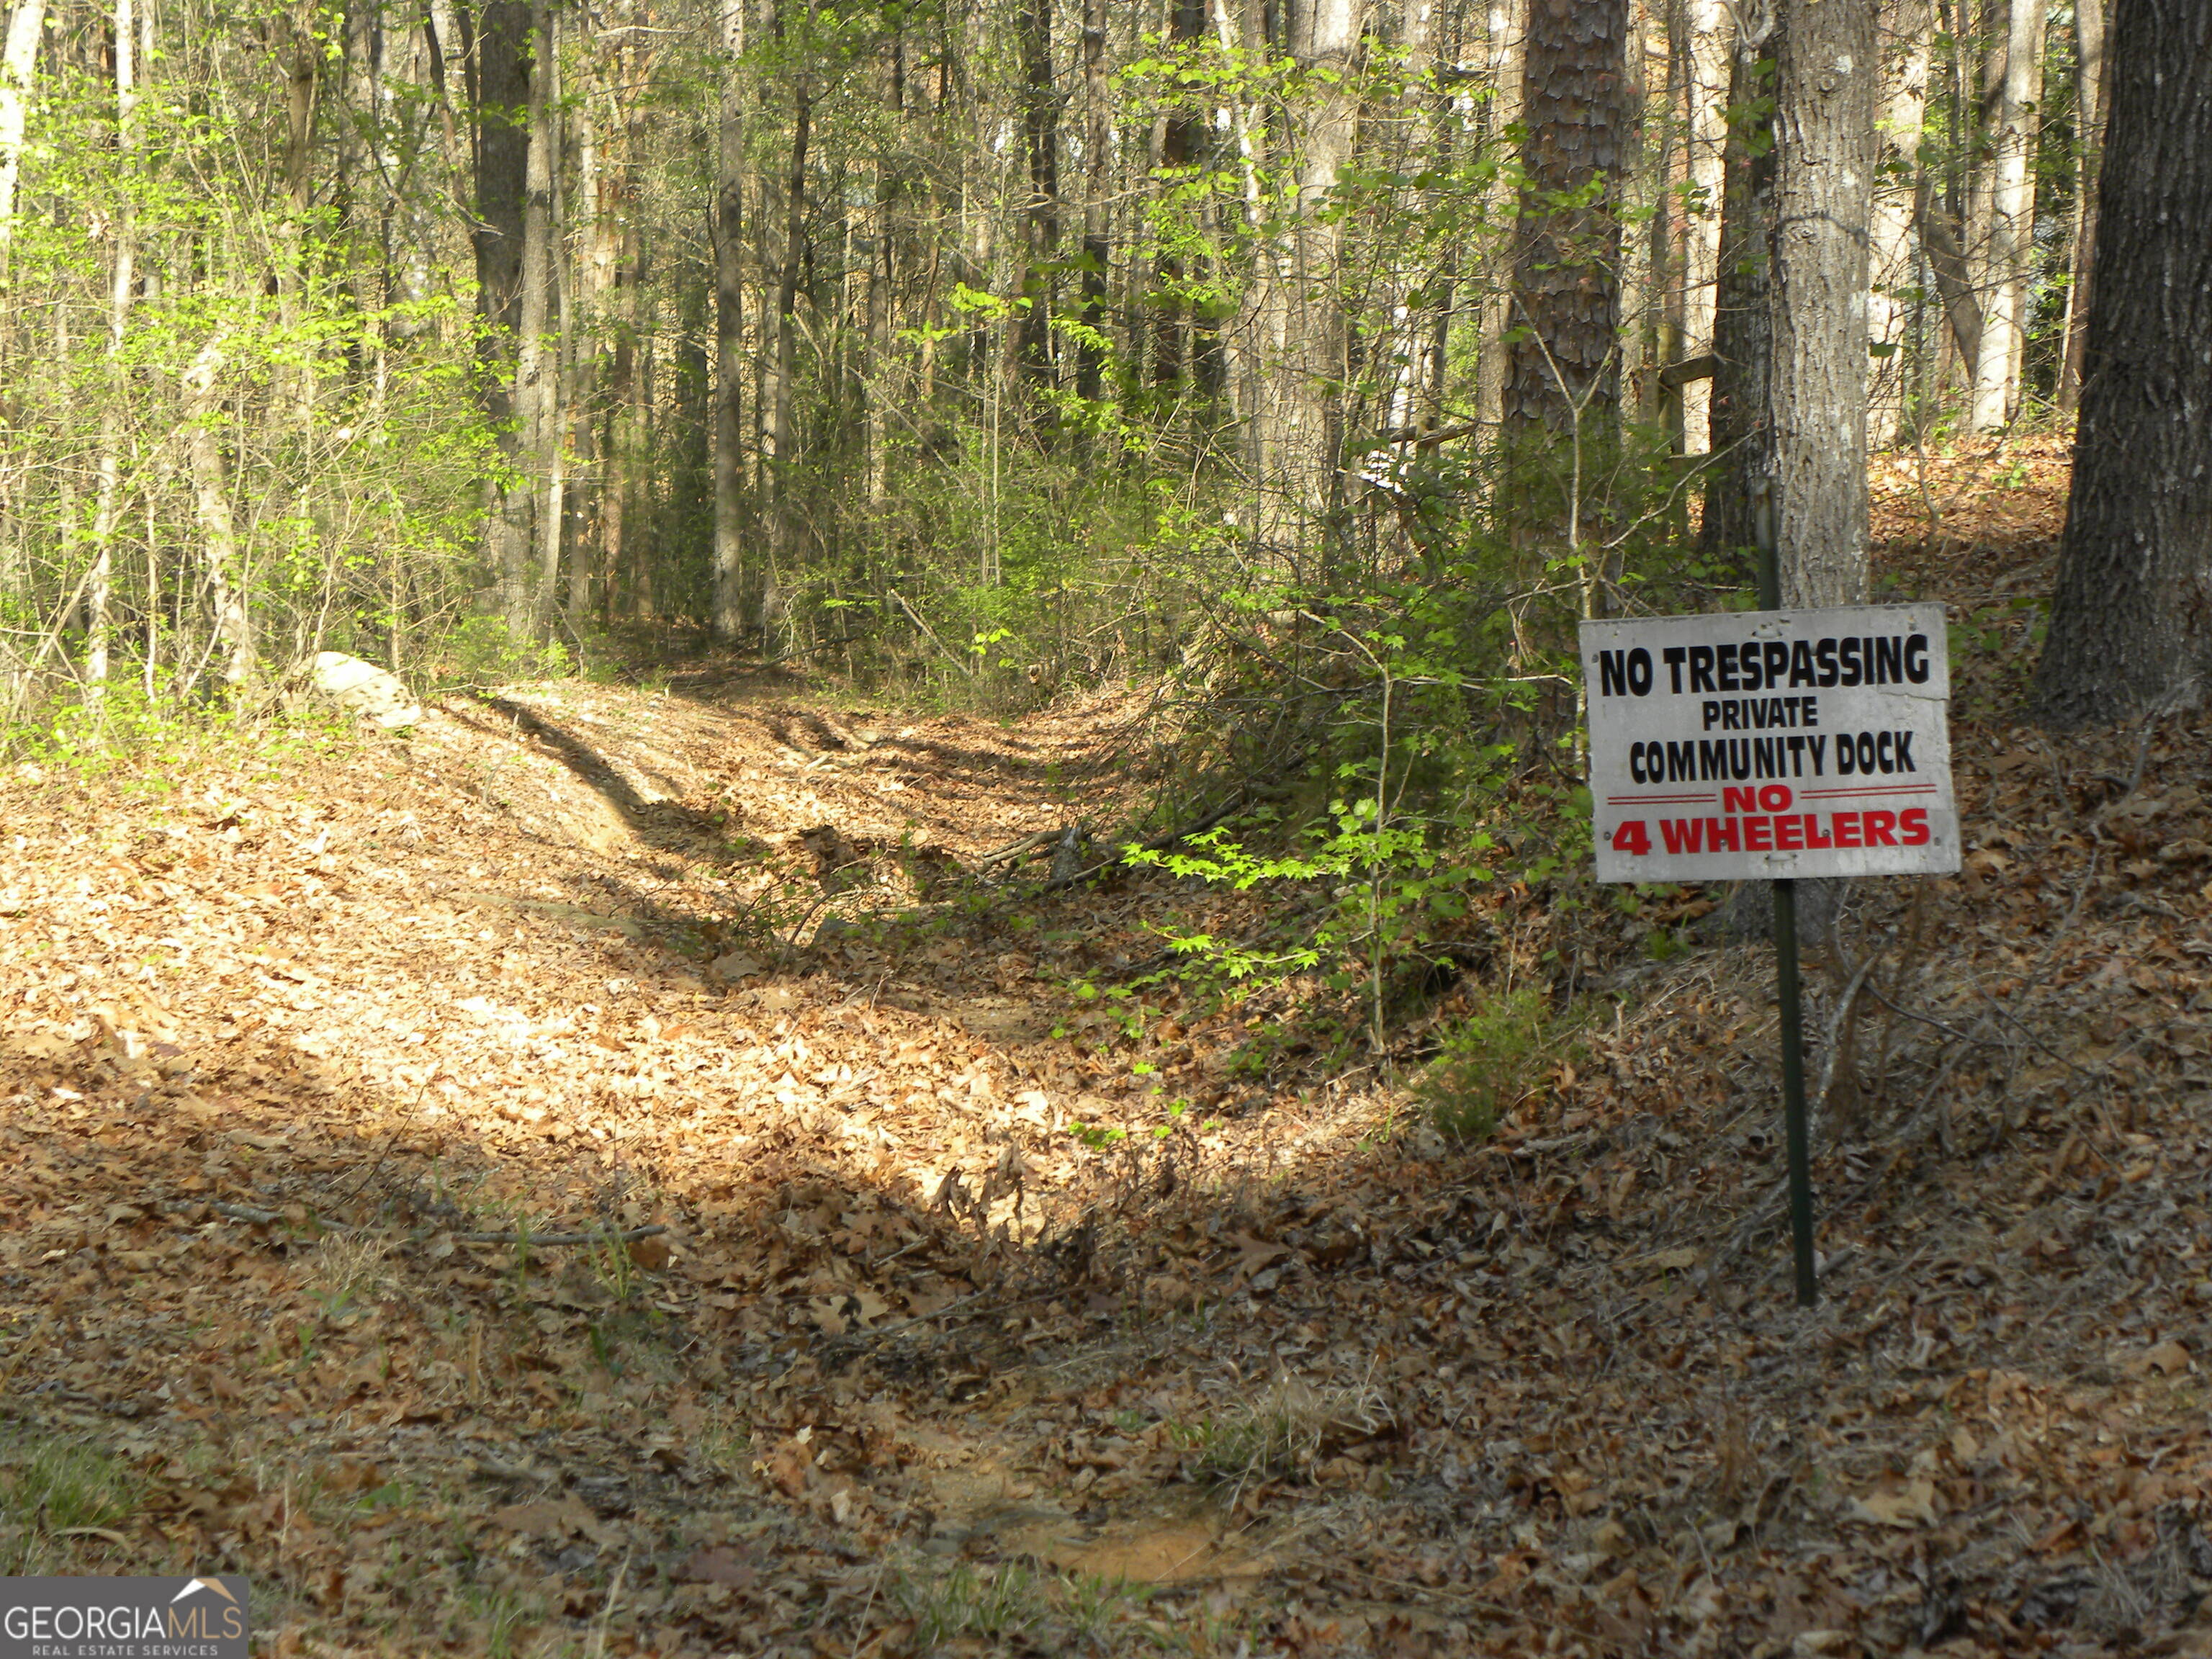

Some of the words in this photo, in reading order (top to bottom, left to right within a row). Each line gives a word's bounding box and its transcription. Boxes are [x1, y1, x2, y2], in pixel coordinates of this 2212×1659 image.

[1600, 648, 1653, 696] NO
[1663, 634, 1929, 694] TRESPASSING
[1702, 696, 1818, 731] PRIVATE
[1630, 734, 1826, 783] COMMUNITY
[1836, 731, 1916, 775] DOCK
[1722, 784, 1793, 813] NO
[1612, 820, 1652, 855] 4
[1659, 808, 1930, 854] WHEELERS
